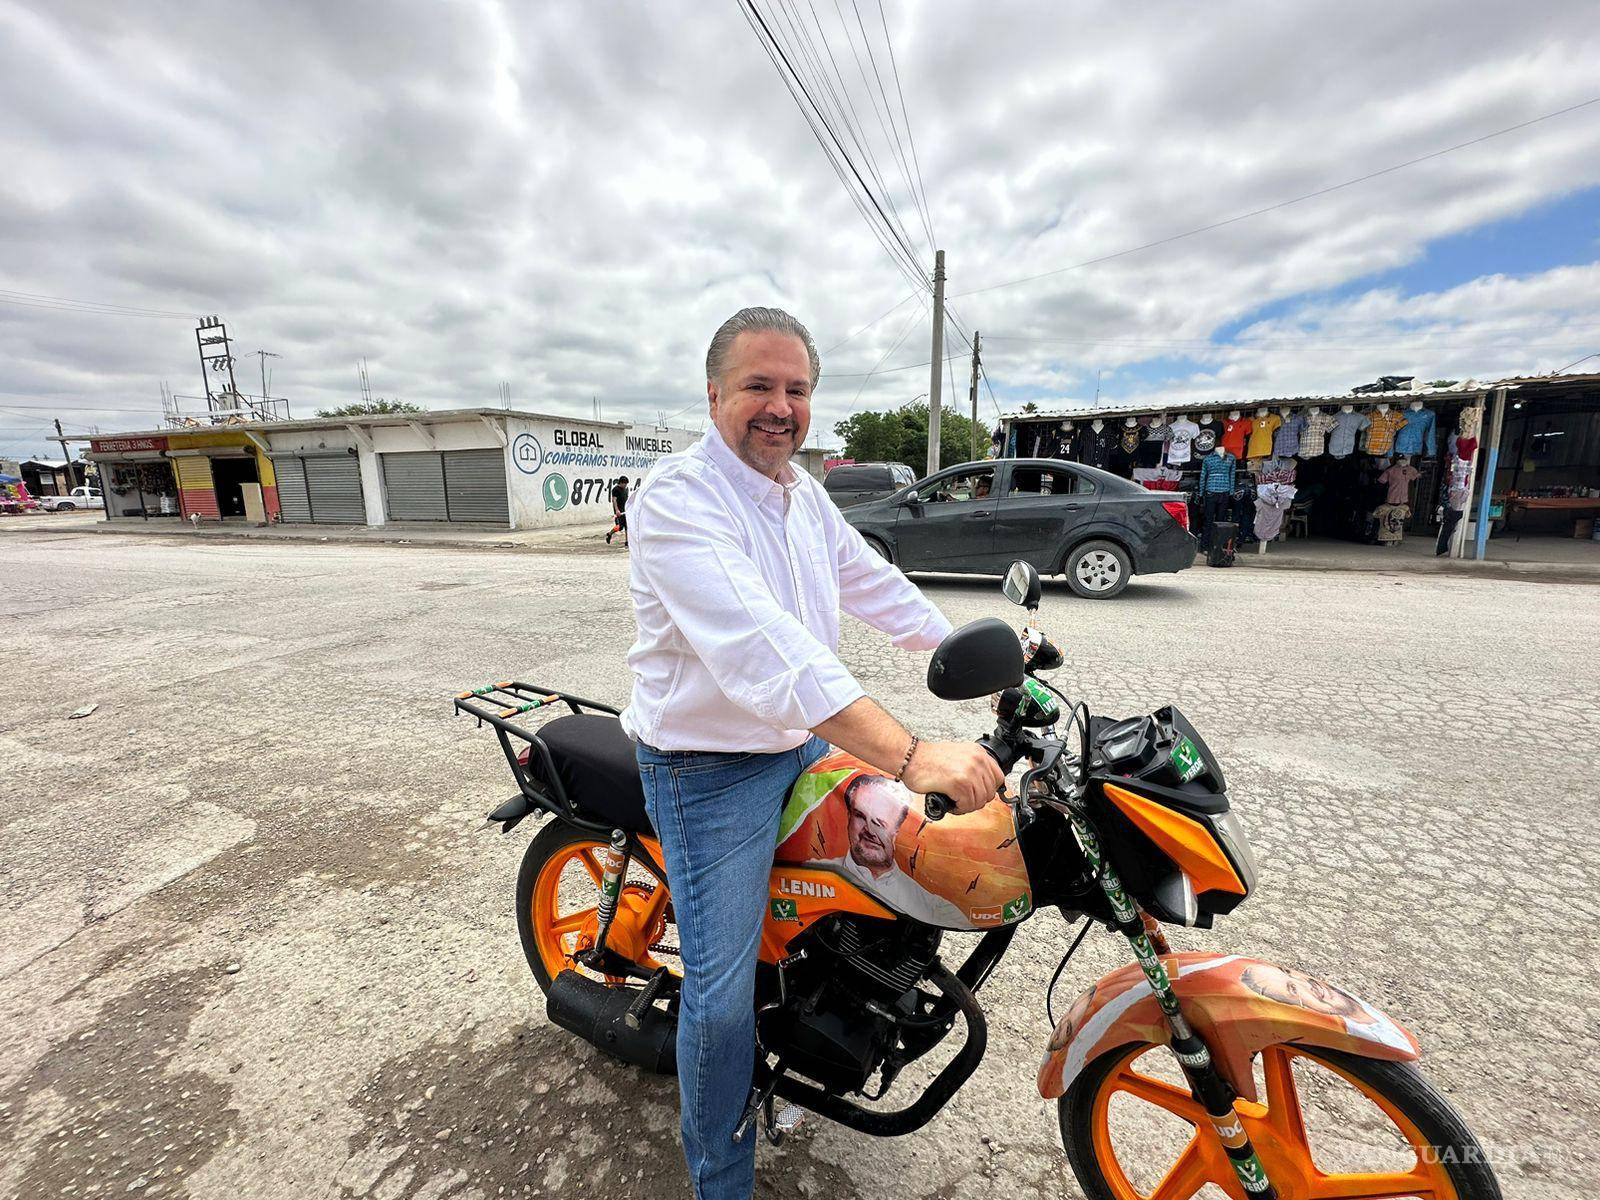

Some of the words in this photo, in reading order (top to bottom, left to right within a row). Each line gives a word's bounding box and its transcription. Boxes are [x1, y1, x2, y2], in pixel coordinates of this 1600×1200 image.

[554, 429, 604, 448] GLOBAL
[625, 436, 672, 453] INMUEBLES
[1060, 444, 1070, 454] 24
[780, 877, 835, 898] LENIN
[972, 912, 1001, 920] UDC
